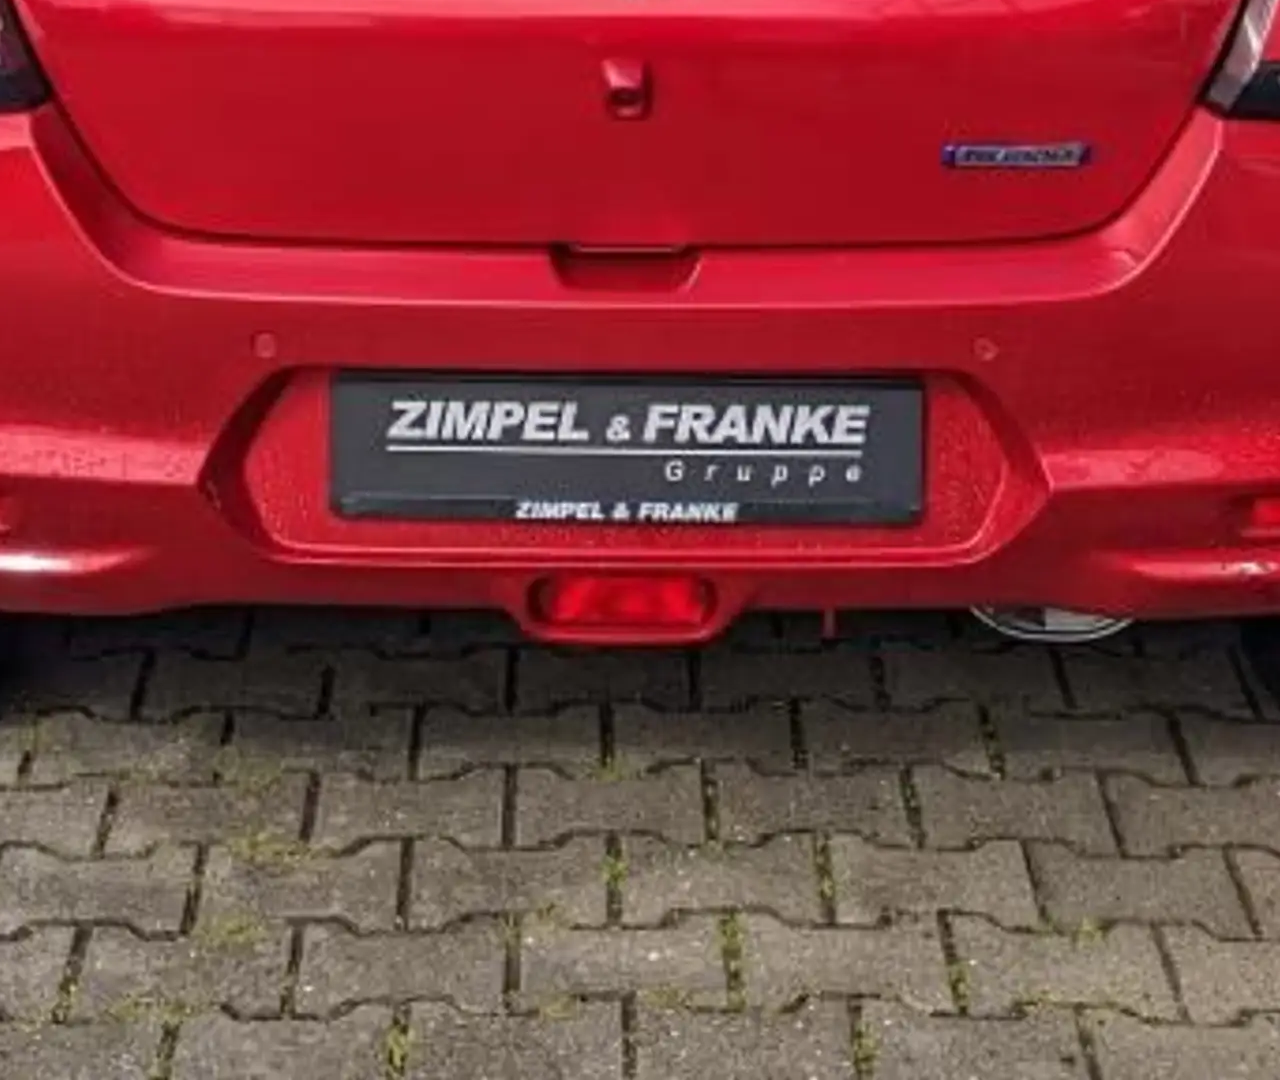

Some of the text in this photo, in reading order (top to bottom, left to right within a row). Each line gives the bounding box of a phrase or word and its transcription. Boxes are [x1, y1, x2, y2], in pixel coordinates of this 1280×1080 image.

[386, 399, 870, 445] ZIMPEL & FRANKE
[664, 460, 863, 487] Gruppe
[515, 500, 739, 522] ZIMPEL & FRANKE
